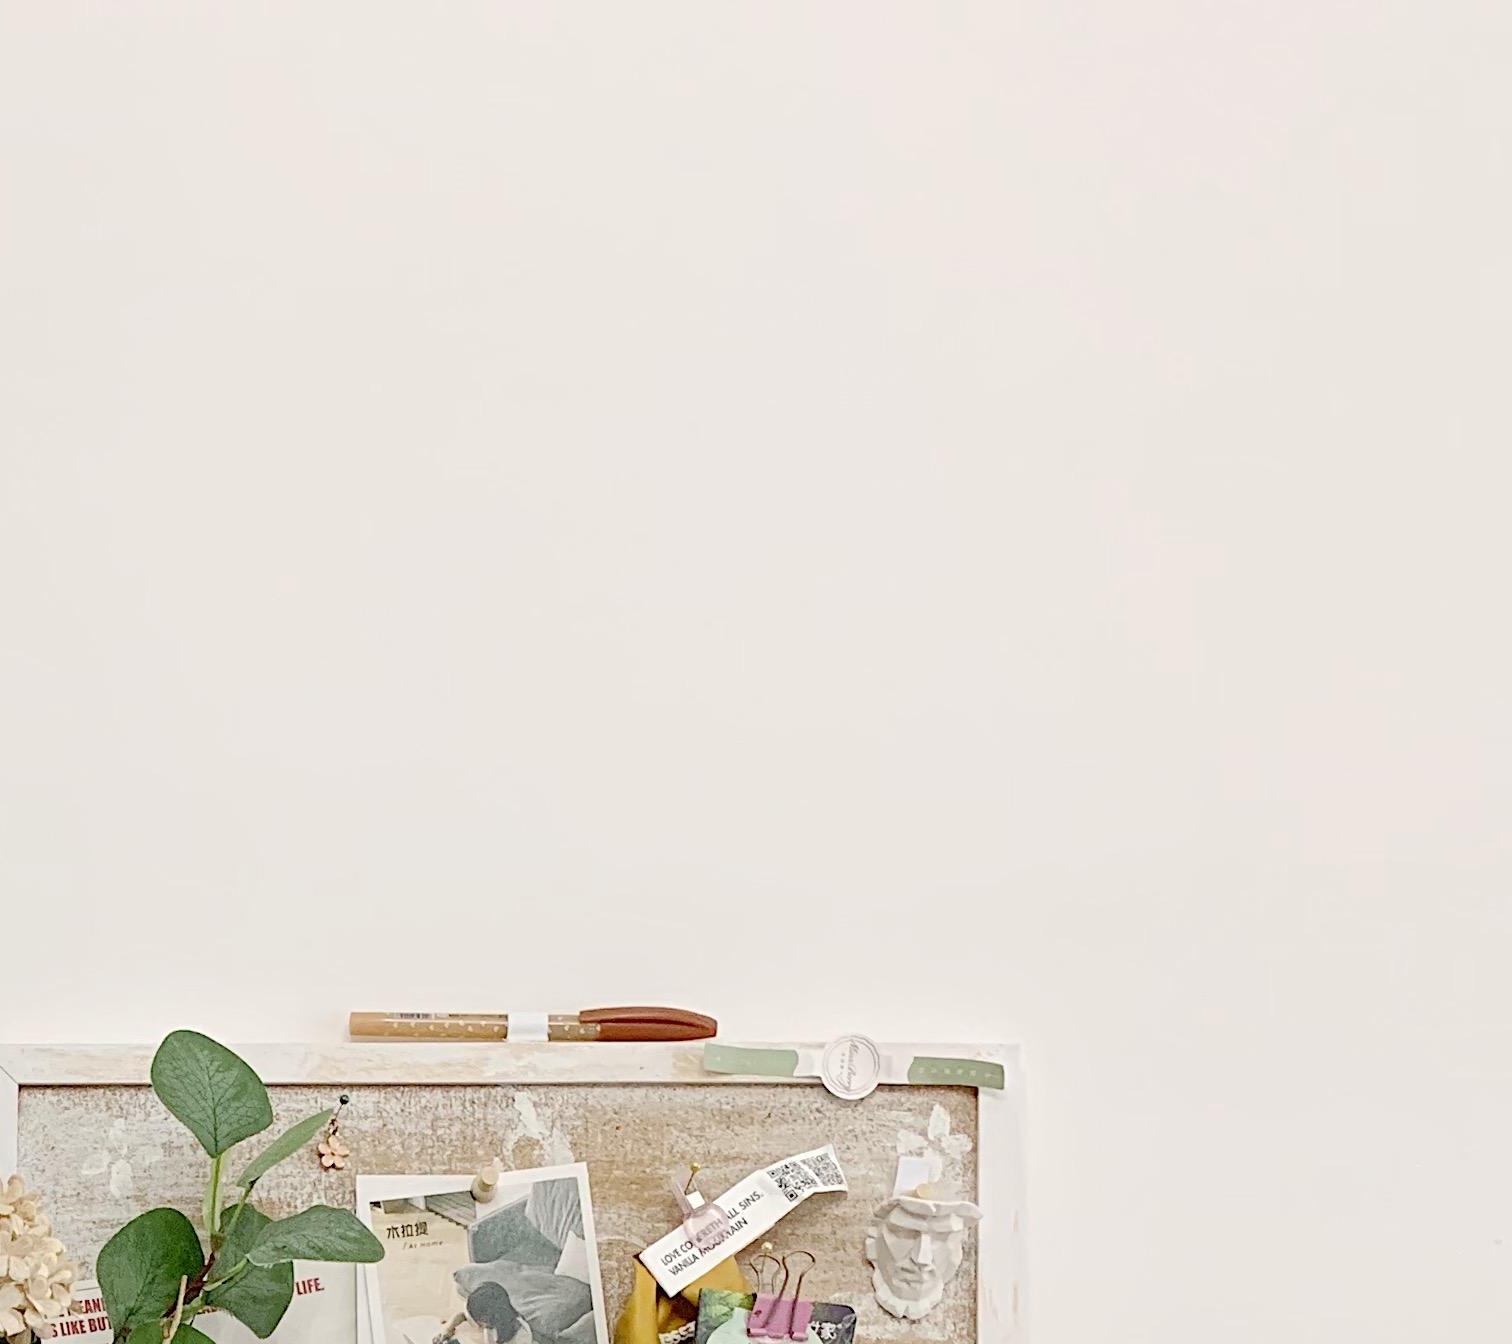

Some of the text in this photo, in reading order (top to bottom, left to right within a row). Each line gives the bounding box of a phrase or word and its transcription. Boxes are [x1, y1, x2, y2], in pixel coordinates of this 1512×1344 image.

[660, 1248, 680, 1266] LOVE
[739, 1190, 764, 1211] SINS.
[667, 1253, 700, 1277] VANILLA
[296, 1278, 325, 1296] LIFE.
[60, 1319, 86, 1337] LIKE
